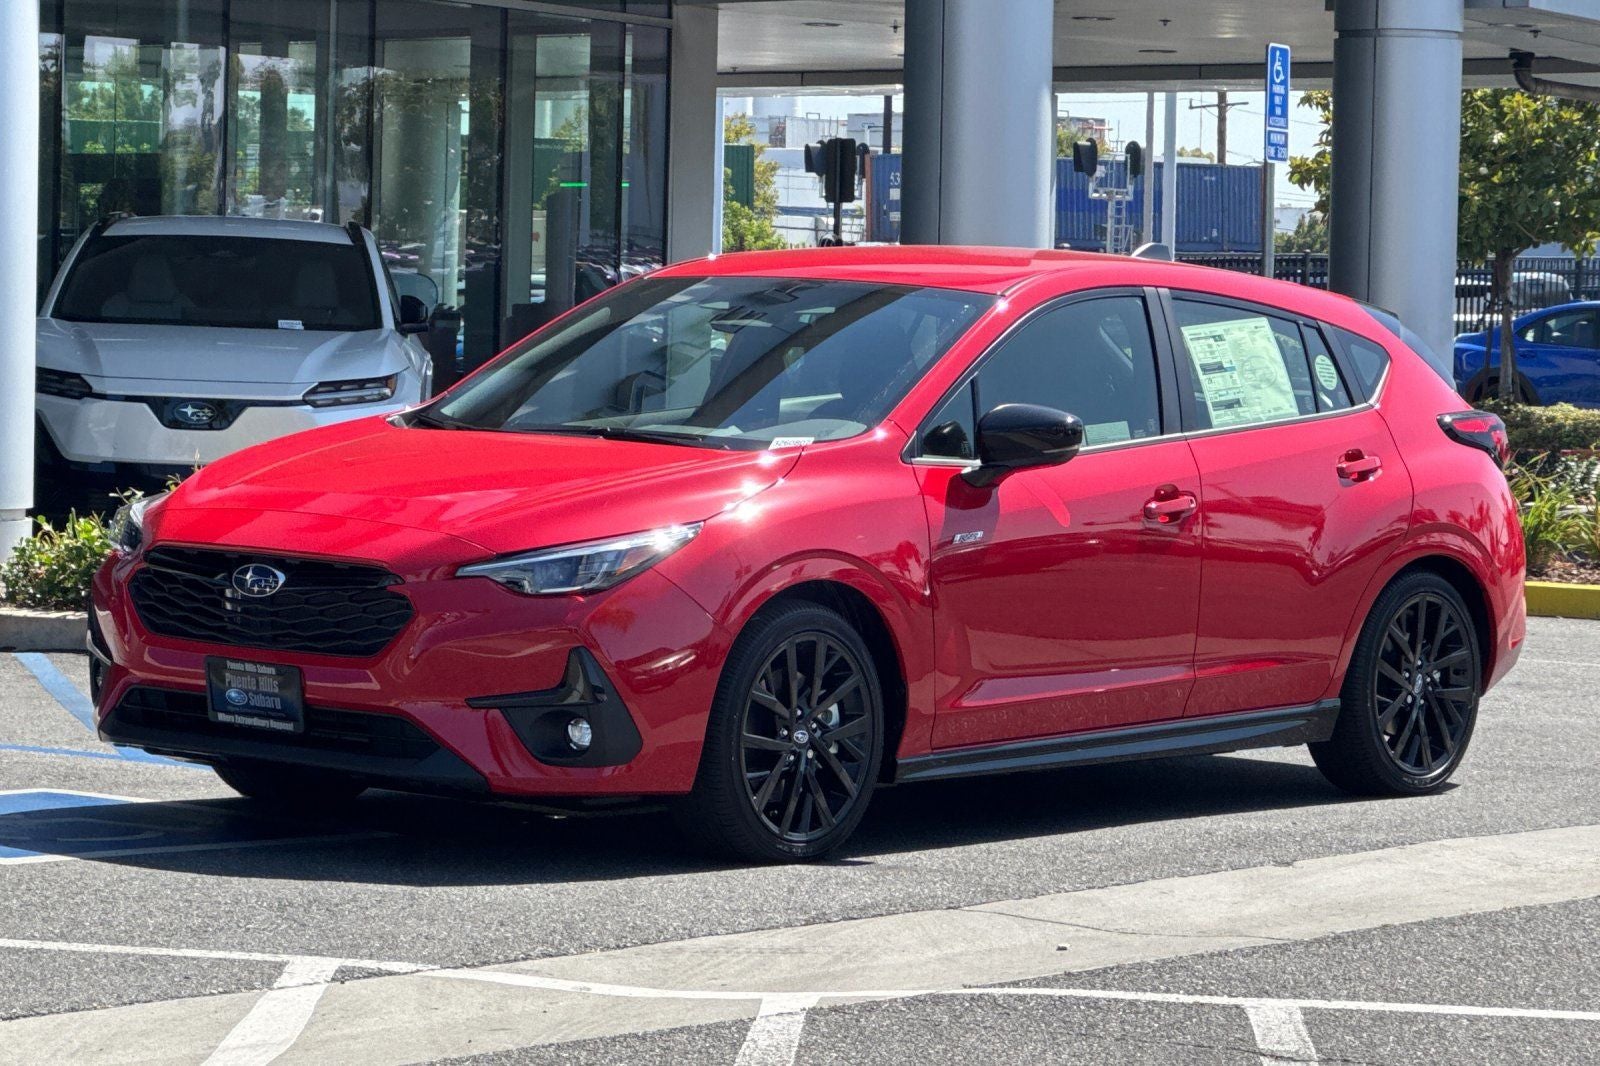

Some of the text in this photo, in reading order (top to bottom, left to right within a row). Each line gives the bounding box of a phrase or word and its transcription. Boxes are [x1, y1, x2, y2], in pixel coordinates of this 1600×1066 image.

[226, 660, 276, 675] Puente Hills Subaru
[225, 672, 279, 693] Puente Hills
[248, 691, 282, 710] Subaru
